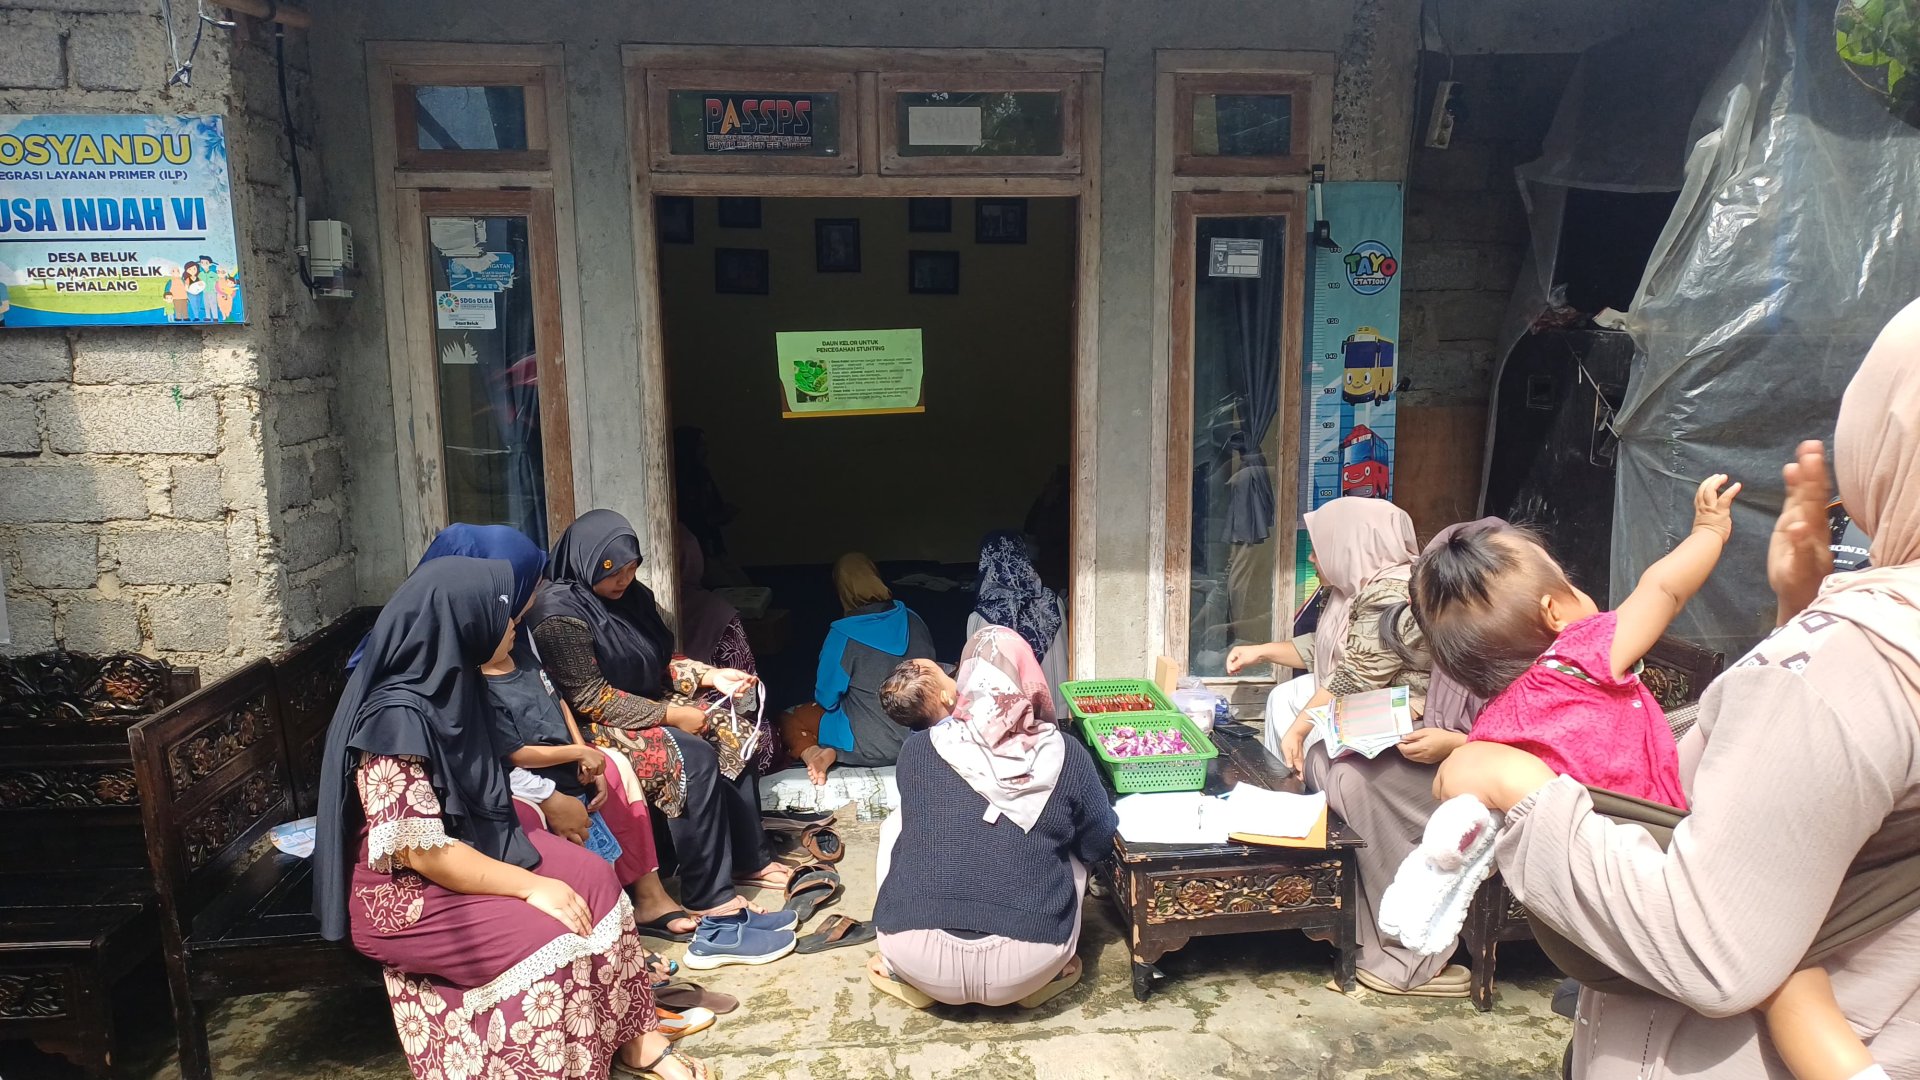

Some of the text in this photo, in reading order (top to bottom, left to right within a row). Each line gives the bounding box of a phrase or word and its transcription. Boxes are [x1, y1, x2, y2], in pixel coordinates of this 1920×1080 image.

[705, 98, 811, 135] PASSPS
[46, 170, 106, 180] LAYANAN
[109, 170, 156, 180] PRIMER
[159, 170, 188, 181] (ILP)
[62, 198, 166, 231] INDAH
[171, 197, 207, 230] VI
[48, 252, 139, 263] DESA BELUK
[1344, 252, 1398, 277] TAYO
[27, 266, 162, 278] KECAMATAN BELIK
[56, 281, 138, 292] PEMALANG
[1353, 278, 1386, 286] STATION
